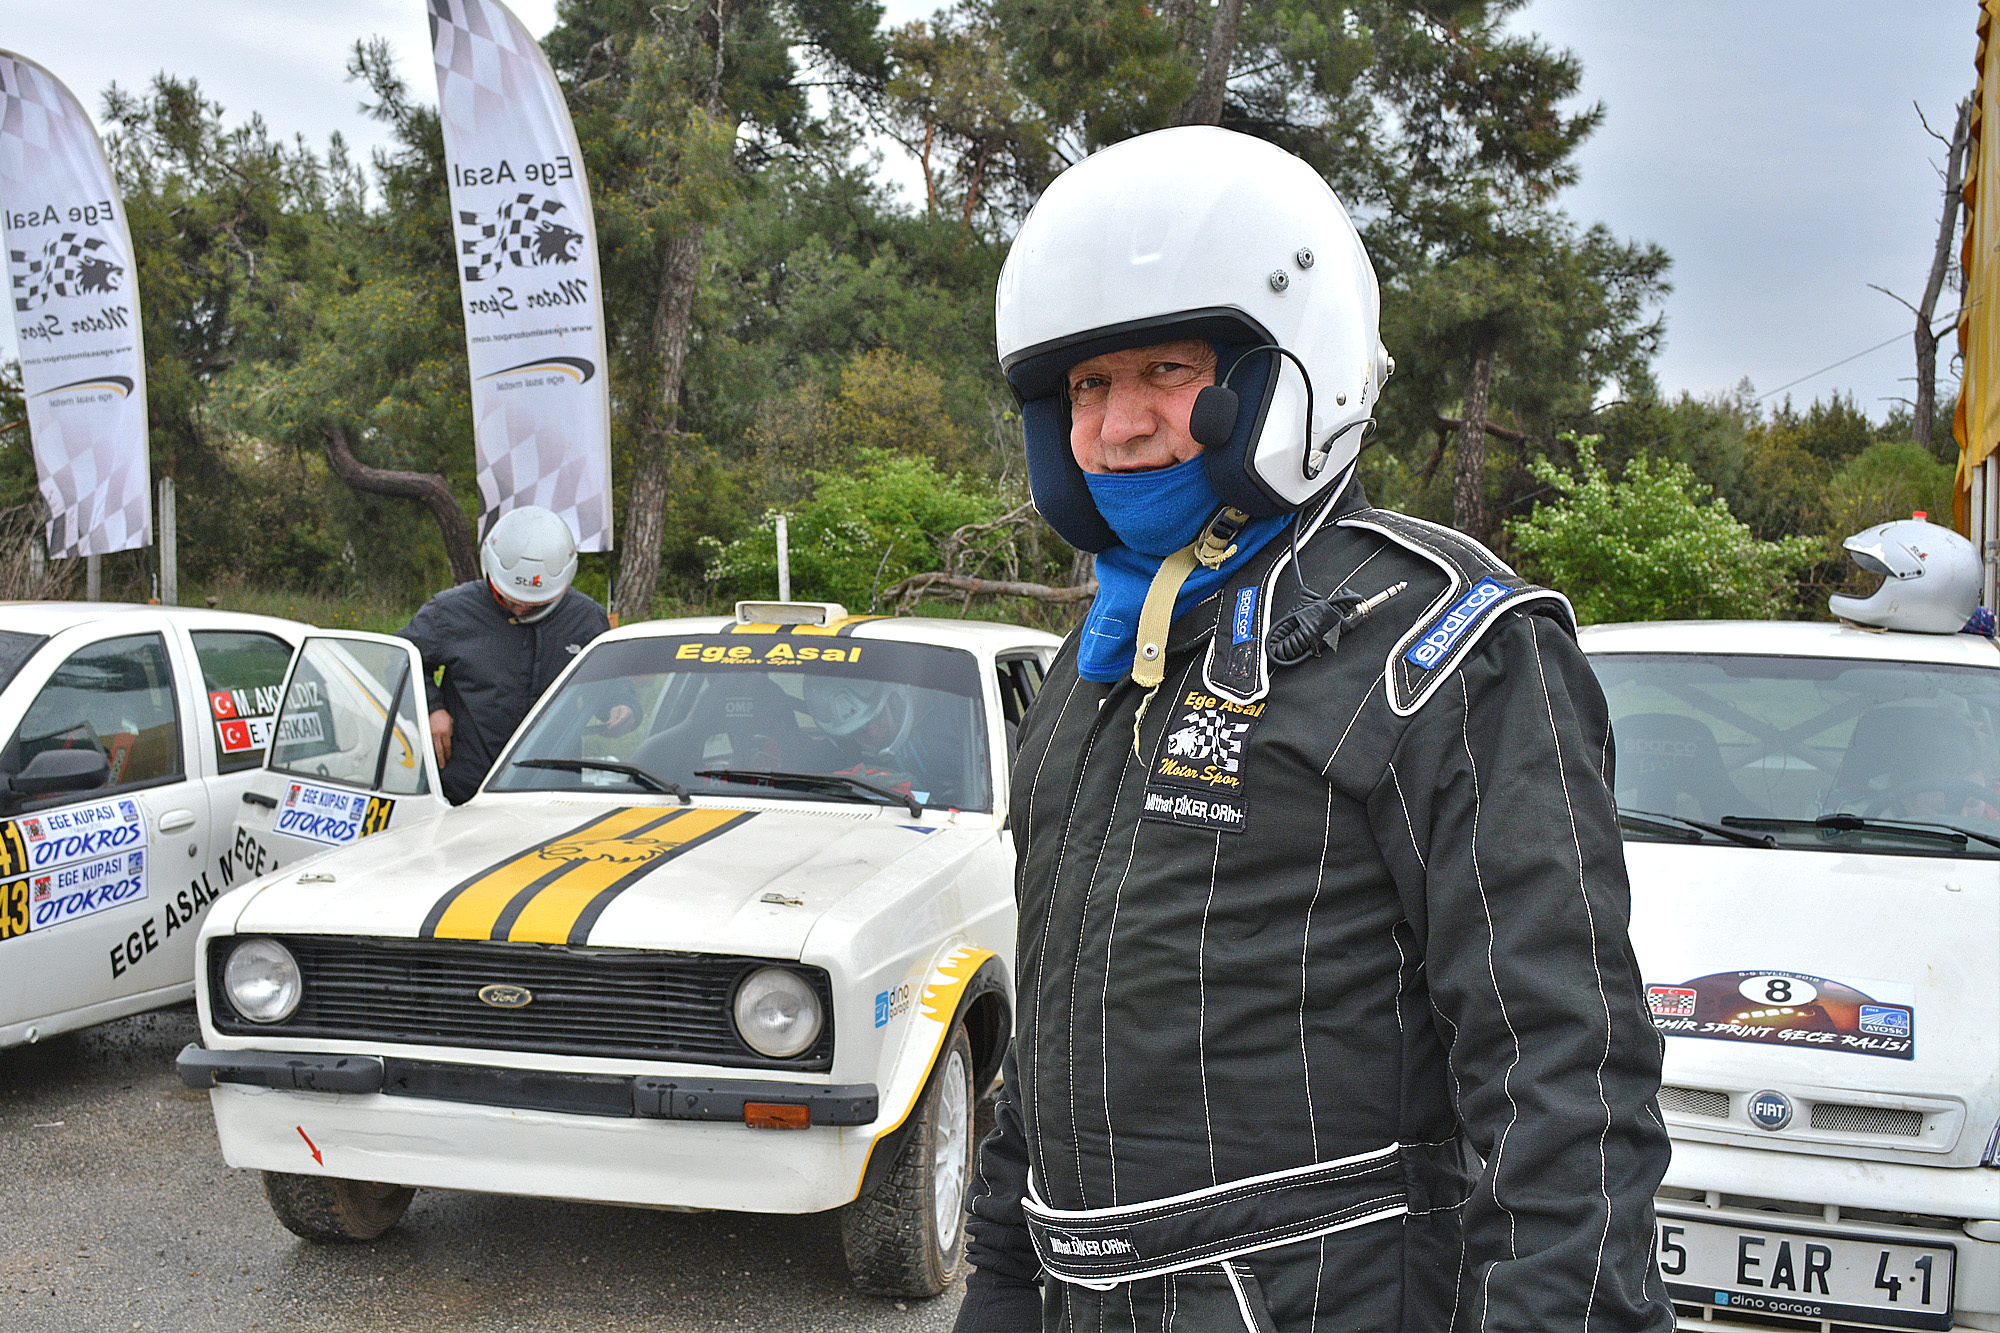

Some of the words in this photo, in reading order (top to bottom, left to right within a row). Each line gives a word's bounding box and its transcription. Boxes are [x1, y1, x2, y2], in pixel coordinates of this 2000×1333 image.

[515, 574, 543, 588] Stilo
[1238, 589, 1253, 635] sparco
[1415, 584, 1504, 665] sparco
[675, 643, 752, 663] Ege
[764, 643, 862, 663] Asal
[719, 656, 763, 665] Motor
[231, 688, 256, 717] M.
[1183, 691, 1217, 711] Ege
[1219, 700, 1266, 718] Asal
[249, 722, 264, 744] E.
[1158, 757, 1198, 779] Motor
[1199, 765, 1240, 788] Spor
[302, 788, 318, 805] EGE
[318, 790, 349, 811] KUPASI
[47, 813, 72, 831] EGE
[72, 805, 116, 823] KUPASI
[280, 809, 357, 841] OTOKROS
[359, 798, 392, 839] 31
[33, 823, 140, 865] OTOKROS
[234, 825, 266, 877] EGE
[58, 871, 80, 889] EGE
[82, 857, 122, 881] KUPASI
[33, 876, 141, 925] OTOKROS
[110, 917, 159, 979] EGE
[165, 871, 220, 938] ASAL
[491, 989, 520, 1003] Ford
[889, 984, 909, 1006] dino
[1765, 979, 1792, 1003] 8
[1653, 1016, 1698, 1032] ZMİR
[1699, 1022, 1776, 1038] SPRINT
[1777, 1028, 1839, 1044] GECE
[1865, 1024, 1904, 1035] AYOSK
[1755, 1101, 1785, 1118] FIAT
[1736, 1235, 1832, 1295] EAR
[1874, 1250, 1933, 1305] 41
[1731, 1294, 1765, 1308] dino
[1768, 1301, 1821, 1316] garage
